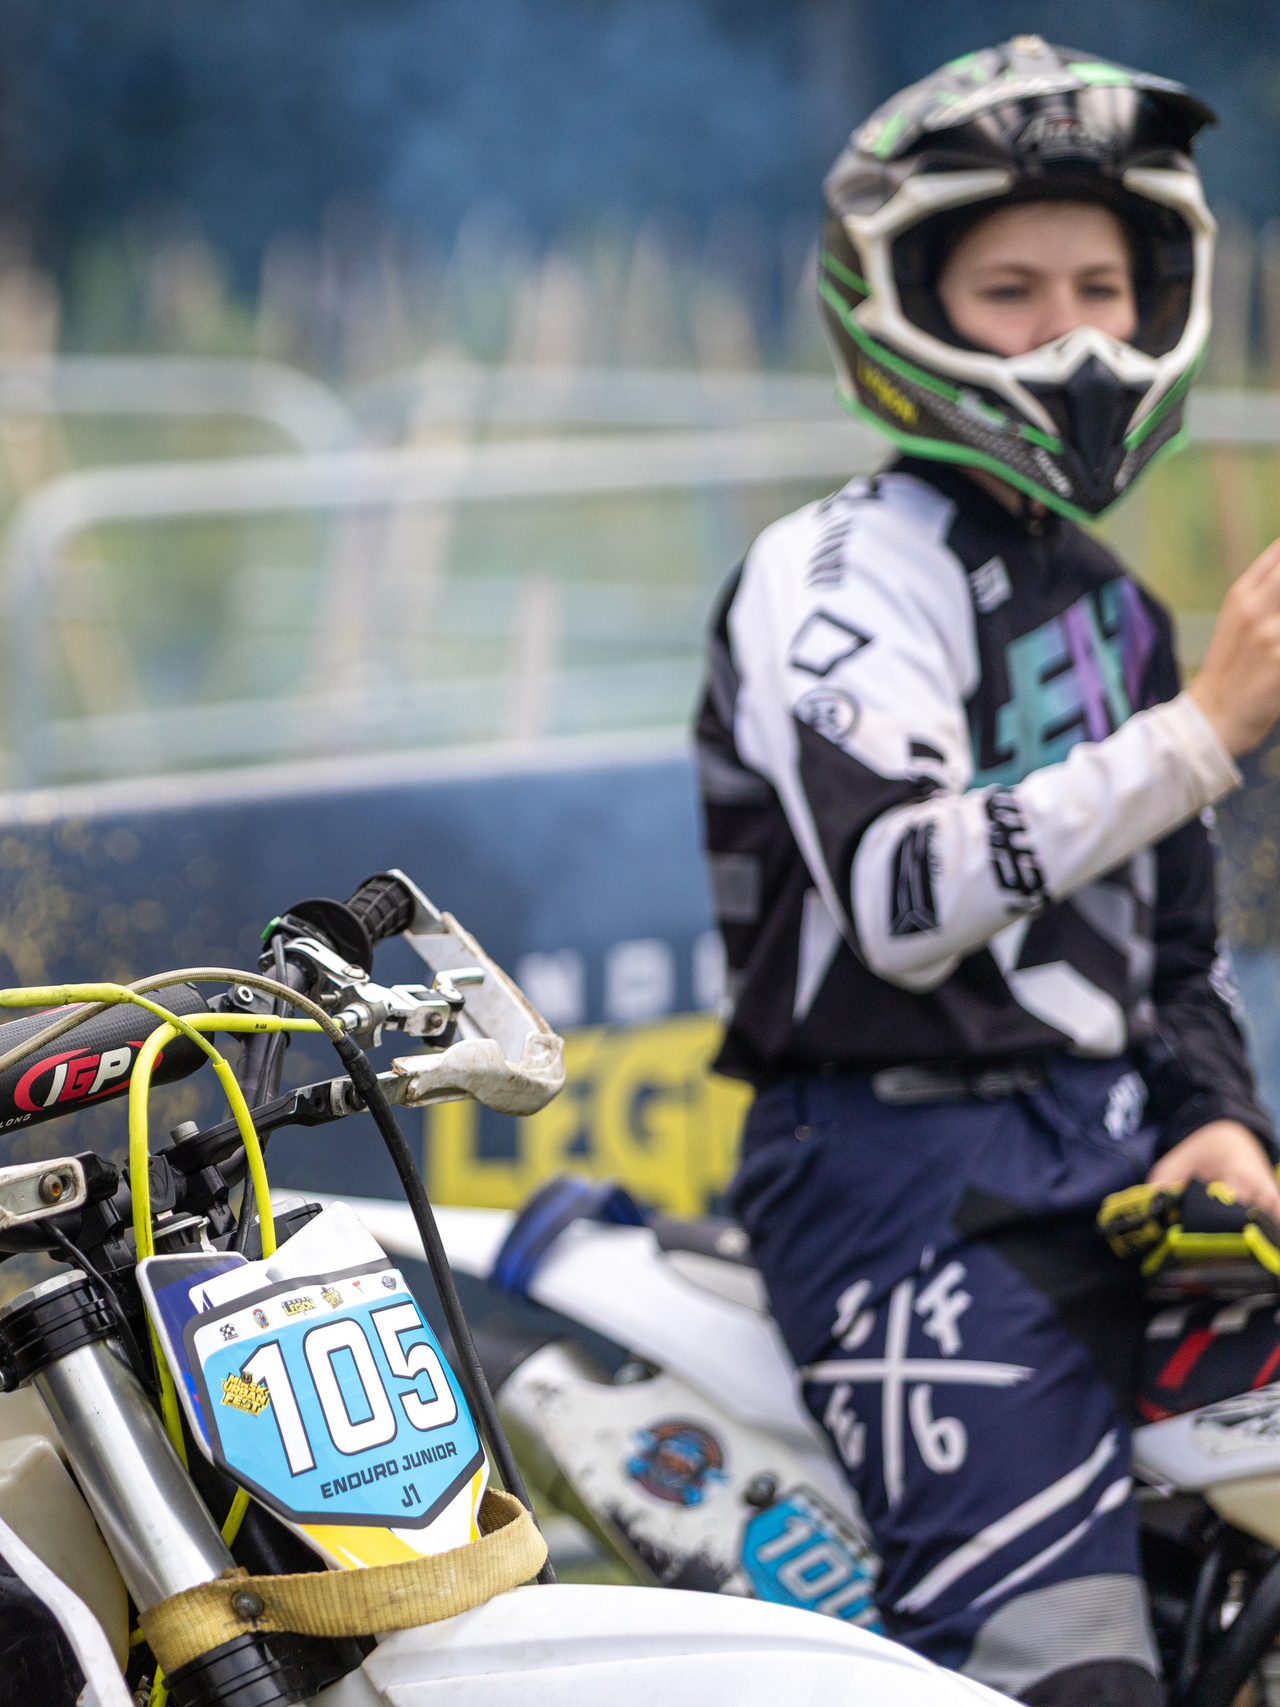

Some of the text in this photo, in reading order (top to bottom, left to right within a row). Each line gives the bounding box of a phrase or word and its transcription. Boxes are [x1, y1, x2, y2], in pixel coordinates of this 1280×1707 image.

[283, 1299, 317, 1317] LEGION
[222, 1380, 269, 1406] URBAN
[238, 1300, 459, 1478] 105
[320, 1441, 458, 1499] ENDURO JUNIOR
[400, 1482, 422, 1508] J1
